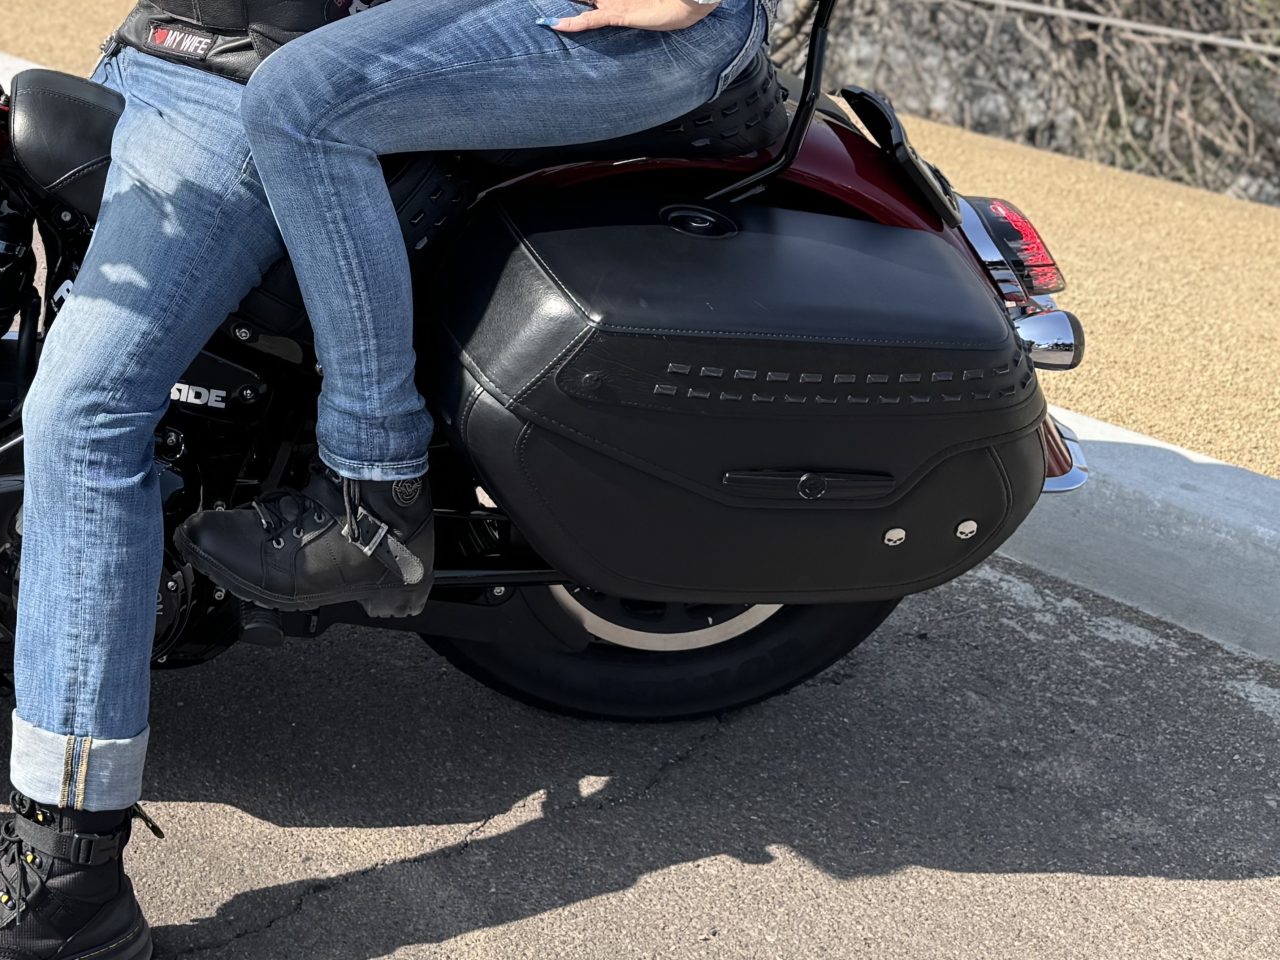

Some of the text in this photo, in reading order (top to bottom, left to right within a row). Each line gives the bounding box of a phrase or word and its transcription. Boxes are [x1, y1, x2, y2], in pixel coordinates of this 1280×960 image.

[147, 25, 212, 54] I MY WIFE
